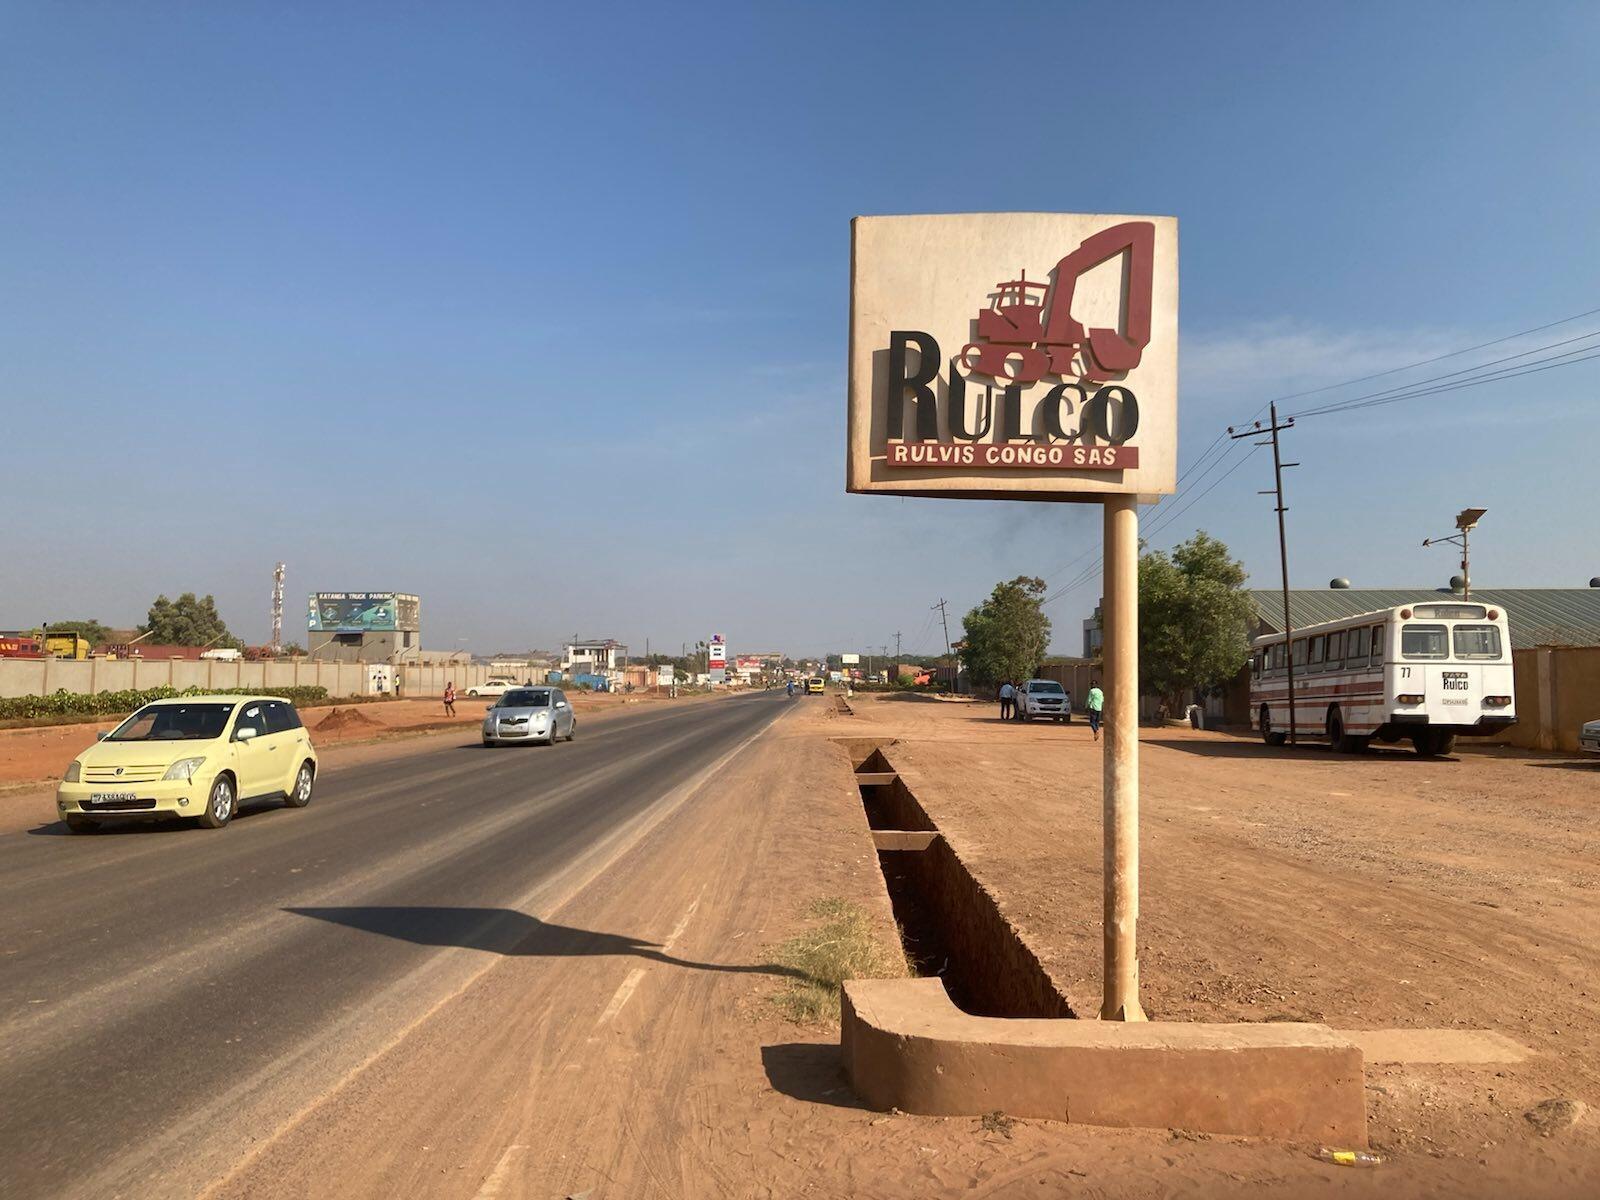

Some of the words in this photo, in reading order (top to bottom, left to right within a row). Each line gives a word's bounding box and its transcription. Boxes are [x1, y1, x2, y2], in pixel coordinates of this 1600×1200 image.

[894, 445, 974, 464] RULVIS
[985, 446, 1063, 464] CONGO
[1074, 449, 1117, 465] SAS
[1401, 667, 1411, 678] 77
